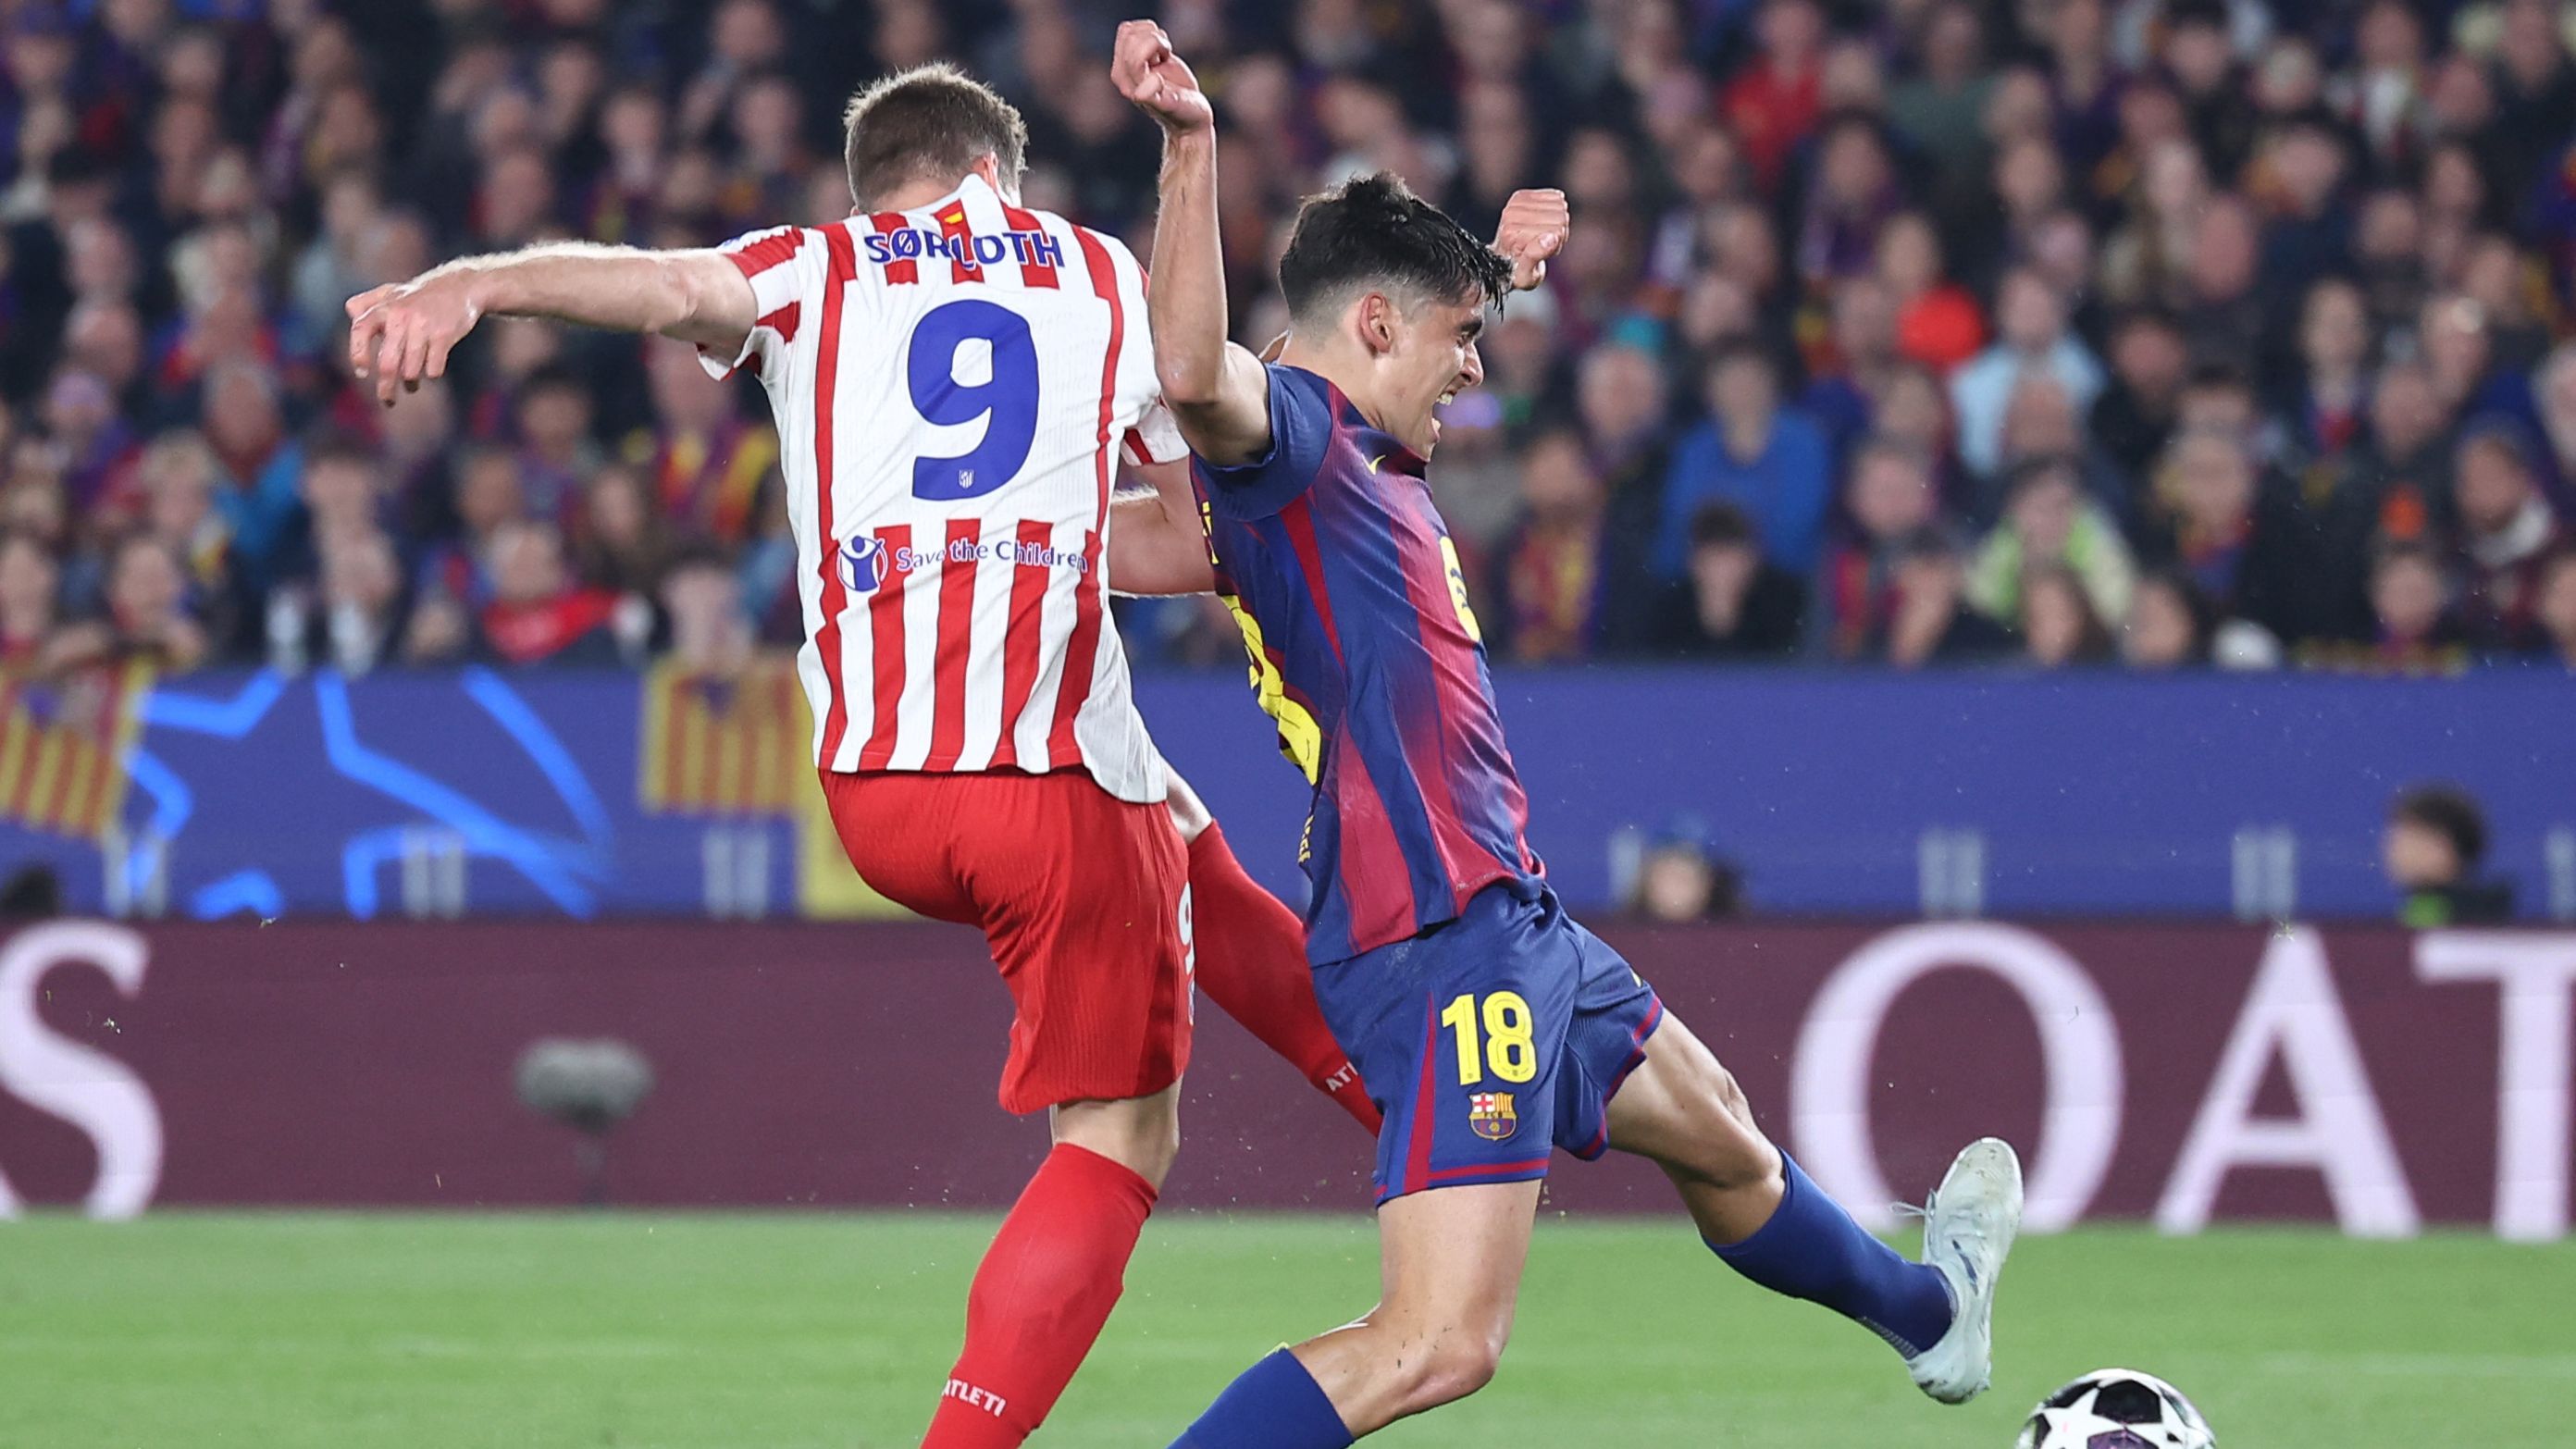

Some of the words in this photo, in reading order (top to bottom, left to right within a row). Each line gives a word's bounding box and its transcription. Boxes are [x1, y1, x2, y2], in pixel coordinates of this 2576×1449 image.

[863, 229, 1066, 270] SØRLOTH
[907, 299, 1040, 502] 9
[896, 546, 946, 573] Save
[949, 539, 988, 563] the
[995, 539, 1089, 573] Children
[1442, 990, 1538, 1086] 18
